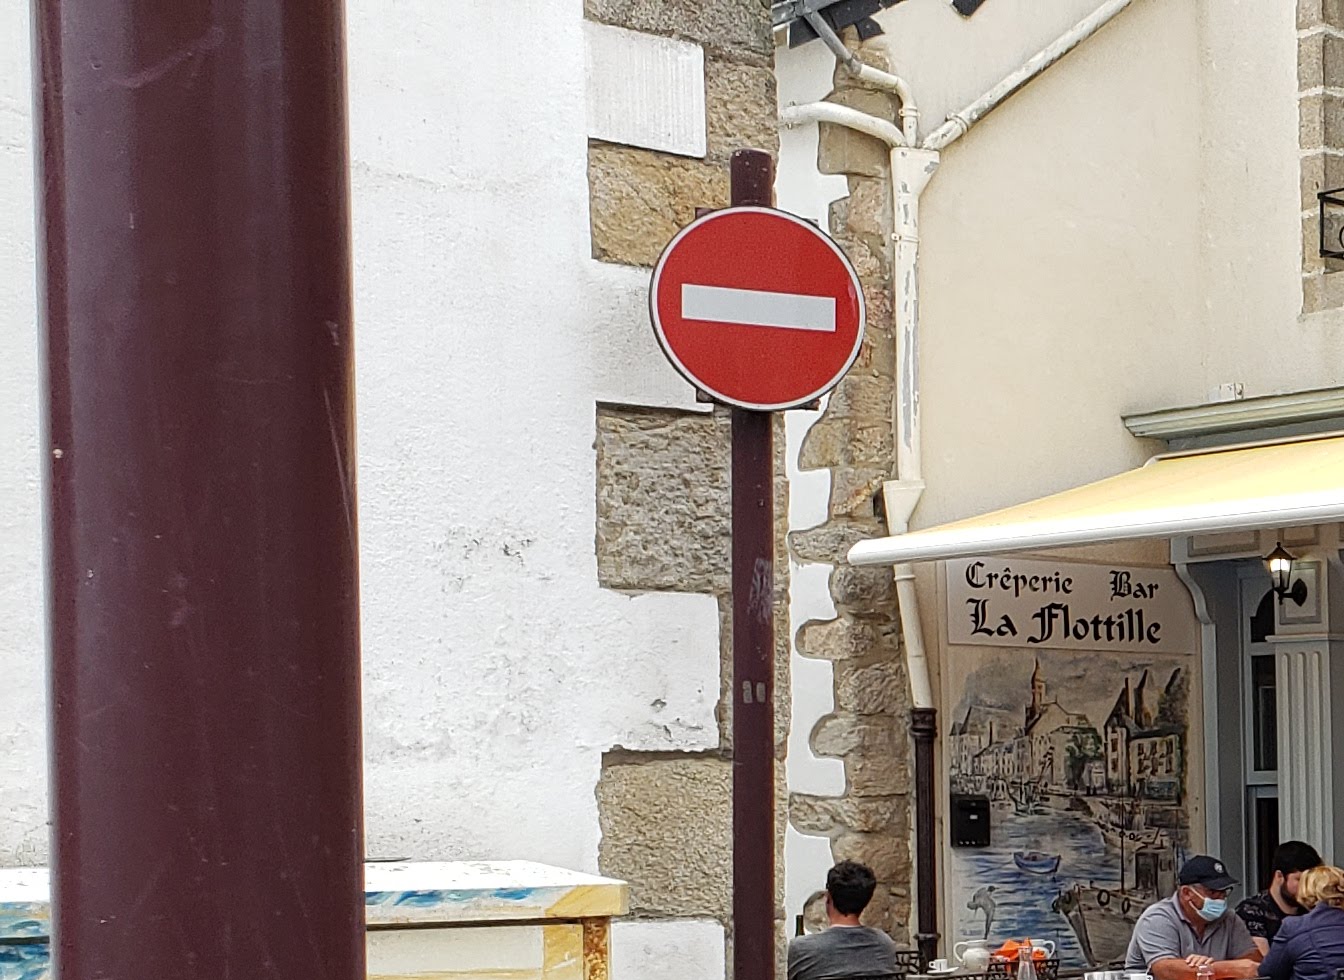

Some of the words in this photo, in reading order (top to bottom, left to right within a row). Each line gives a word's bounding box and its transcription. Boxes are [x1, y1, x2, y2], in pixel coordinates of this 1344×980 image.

[965, 561, 1073, 598] Crêperie
[1109, 570, 1159, 601] Bar
[966, 598, 1018, 637] La
[1027, 602, 1162, 644] Flottille
